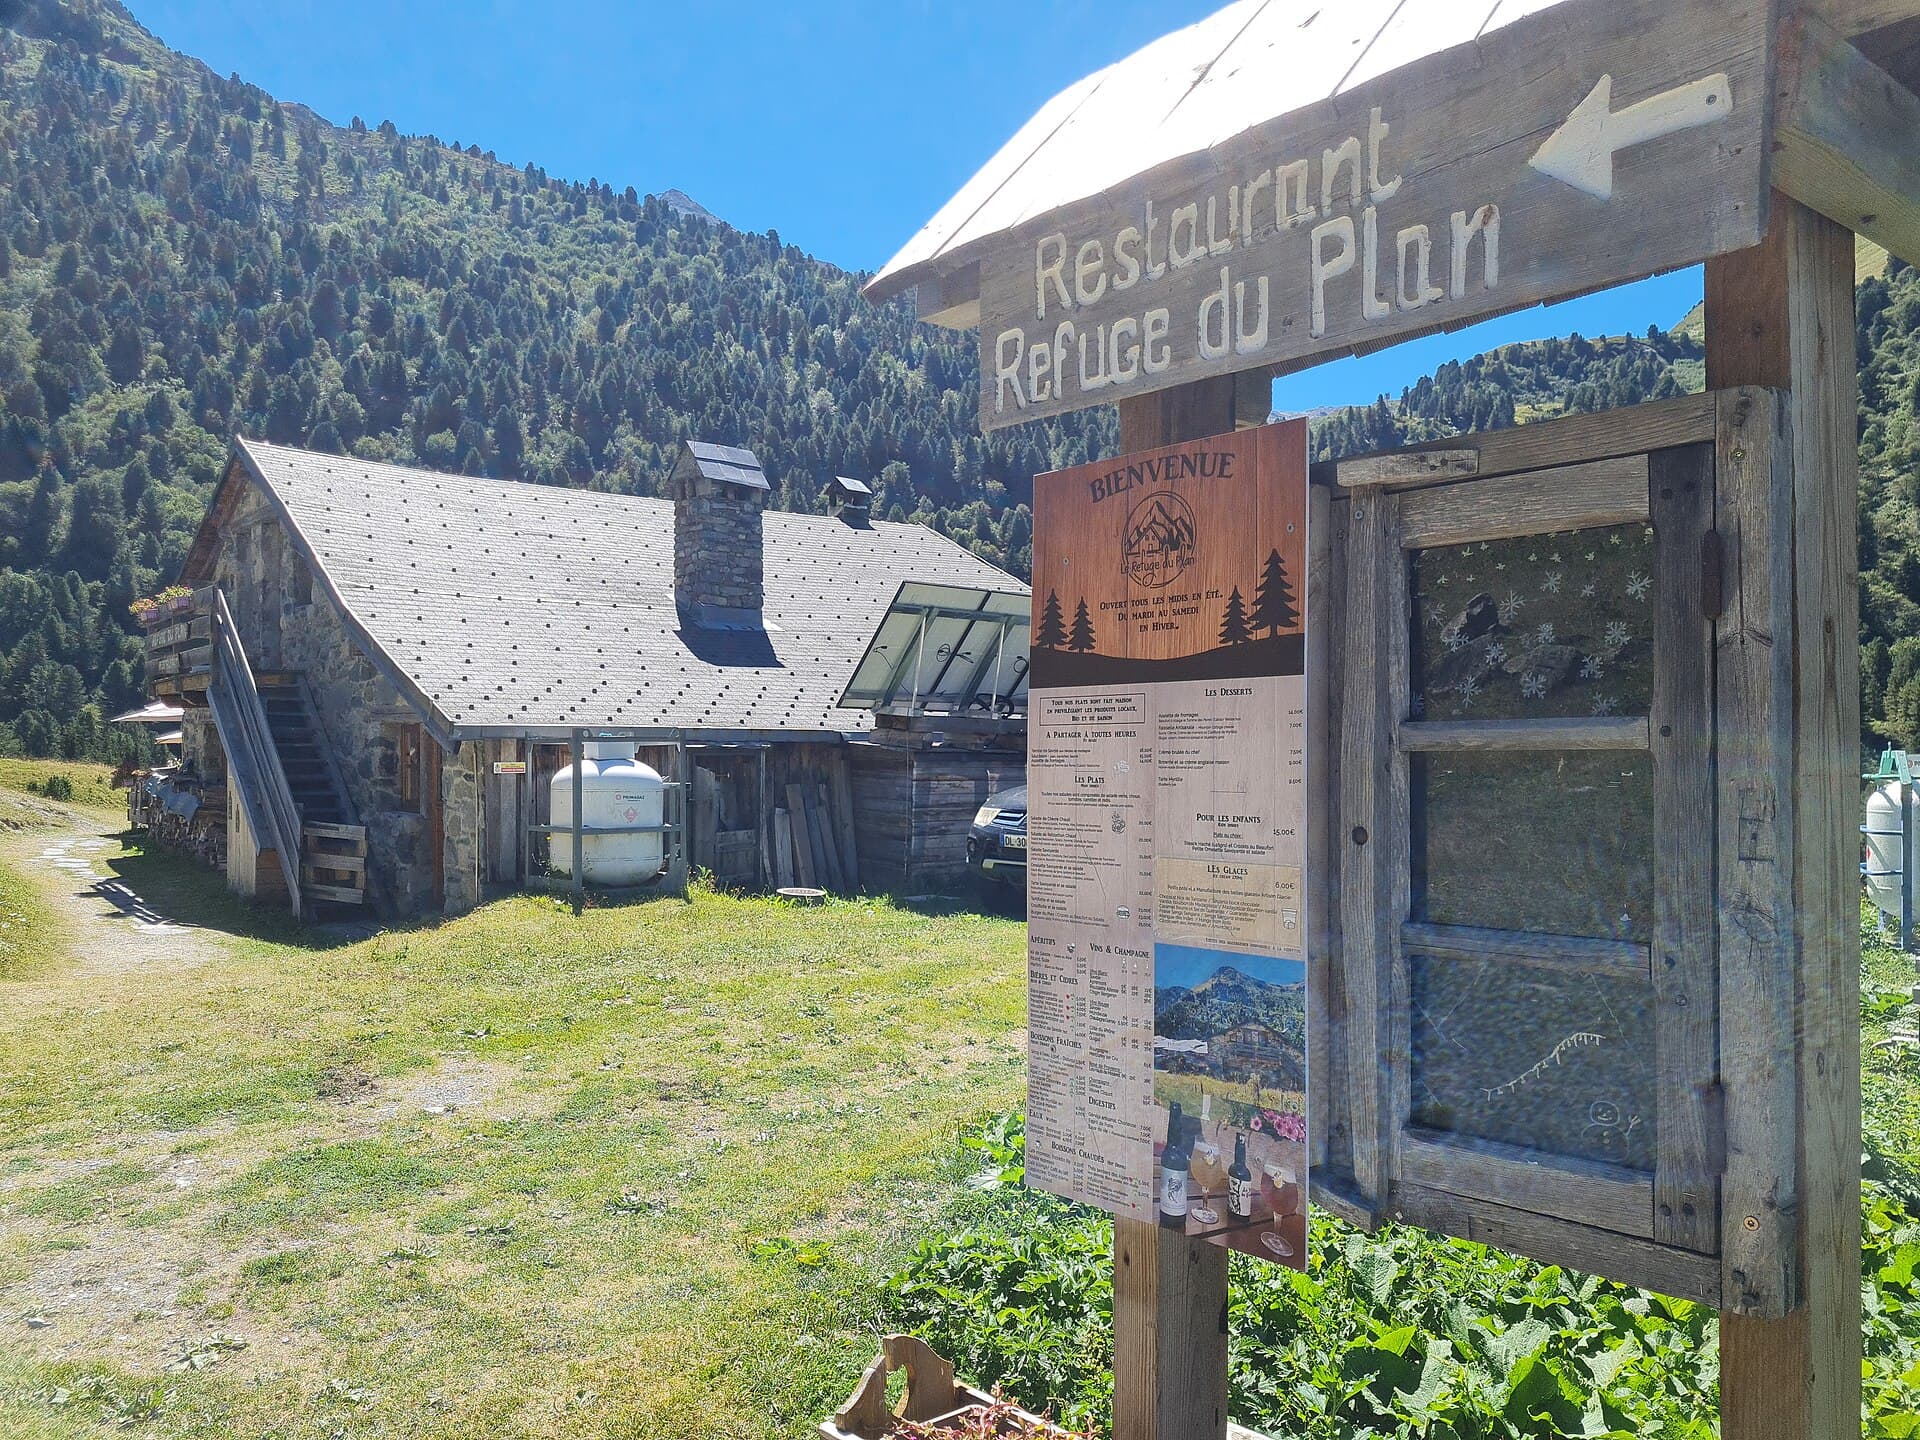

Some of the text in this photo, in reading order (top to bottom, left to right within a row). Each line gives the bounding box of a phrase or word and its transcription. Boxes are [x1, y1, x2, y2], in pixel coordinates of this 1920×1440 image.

[1034, 105, 1403, 322] Restaurant
[993, 203, 1501, 413] Refuge du Plan
[1089, 452, 1236, 504] BIENVENUE
[1119, 543, 1196, 583] Le Refuge du Plan
[1099, 600, 1128, 611] OUVERT
[1131, 598, 1149, 608] TOUS
[1152, 597, 1165, 606] LES
[1168, 595, 1188, 604] MIDIS
[1192, 593, 1202, 601] EN
[1132, 610, 1155, 621] MARDI
[1158, 609, 1168, 618] AU
[1172, 606, 1200, 617] SAMEDI
[1139, 623, 1150, 632] EN
[1205, 688, 1253, 697] LES DESSERTS
[1074, 776, 1105, 784] LES PLATS
[1196, 813, 1214, 822] POUR
[1232, 816, 1261, 824] ENFANTS
[1223, 866, 1248, 876] GLACES
[1106, 946, 1112, 954] &
[1114, 946, 1150, 959] CHAMPAGNE
[1059, 975, 1078, 986] CIDRES
[1030, 1031, 1082, 1050] BOISSONS FRAÎCHES
[1088, 1096, 1116, 1110] DIGESTIFS
[1052, 1140, 1076, 1156] BOISSONS
[1078, 1148, 1105, 1164] CHAUDES
